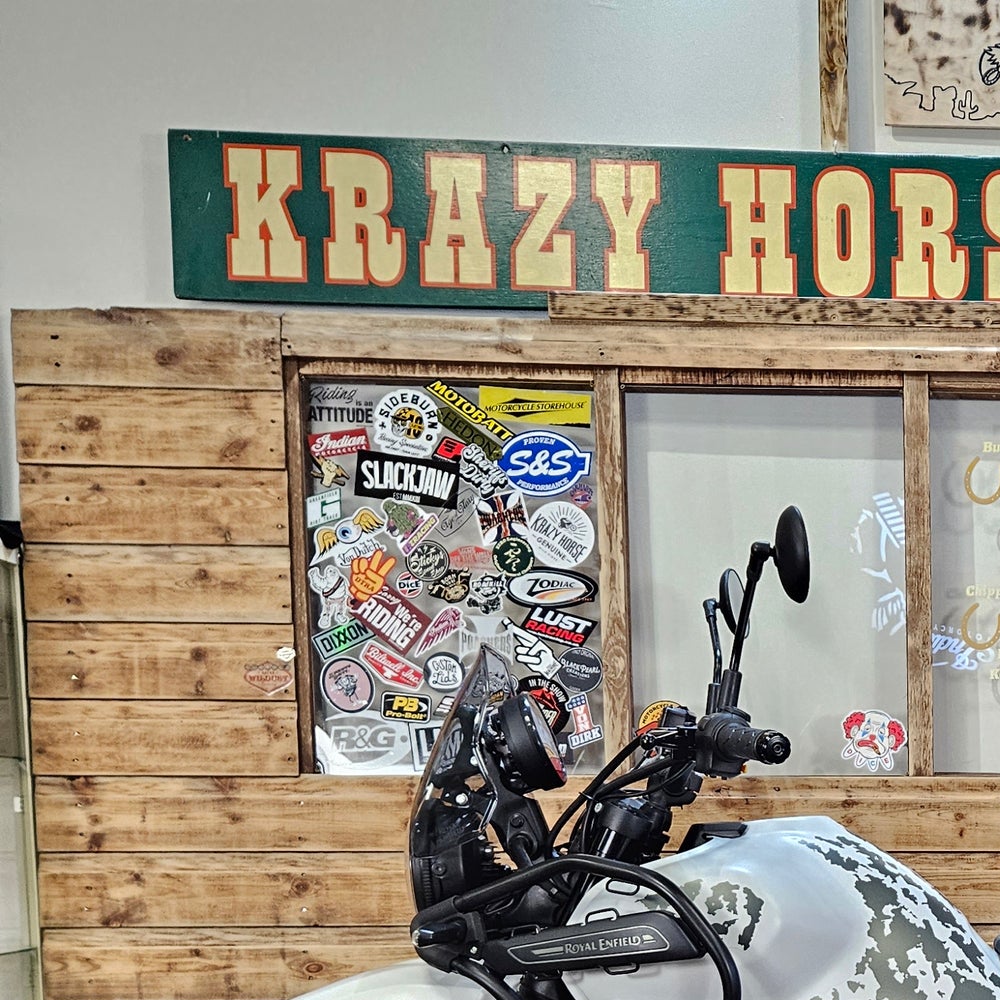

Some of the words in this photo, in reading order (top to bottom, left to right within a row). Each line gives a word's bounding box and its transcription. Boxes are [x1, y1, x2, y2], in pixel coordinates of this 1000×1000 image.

[222, 141, 661, 292] KRAZY
[309, 386, 358, 404] Riding
[308, 406, 373, 423] ATTITUDE
[379, 393, 438, 430] SIDEBURN
[431, 380, 515, 440] MOTOBATT
[485, 404, 534, 412] MOTORCYCLE
[536, 401, 586, 410] STOREHOUSE
[311, 433, 366, 453] Indian
[523, 437, 556, 446] PROVEN
[507, 450, 573, 476] S&S
[361, 460, 456, 500] SLACKJAW
[516, 477, 570, 491] PERFORMANCE
[530, 513, 561, 541] KRAZY
[559, 534, 588, 563] HORSE
[536, 537, 566, 561] GENUINE
[527, 578, 575, 597] ZODIAC
[358, 597, 416, 649] RIDING
[532, 606, 592, 633] LUST
[320, 622, 369, 653] DIXXON
[525, 619, 585, 644] RACING
[392, 696, 419, 712] PB
[550, 684, 566, 703] SHOW
[385, 710, 423, 719] Pro-Bolt
[333, 726, 396, 750] R&G
[571, 728, 601, 747] DIRK
[565, 943, 597, 954] ROYAL
[599, 935, 641, 951] ENFIELD
